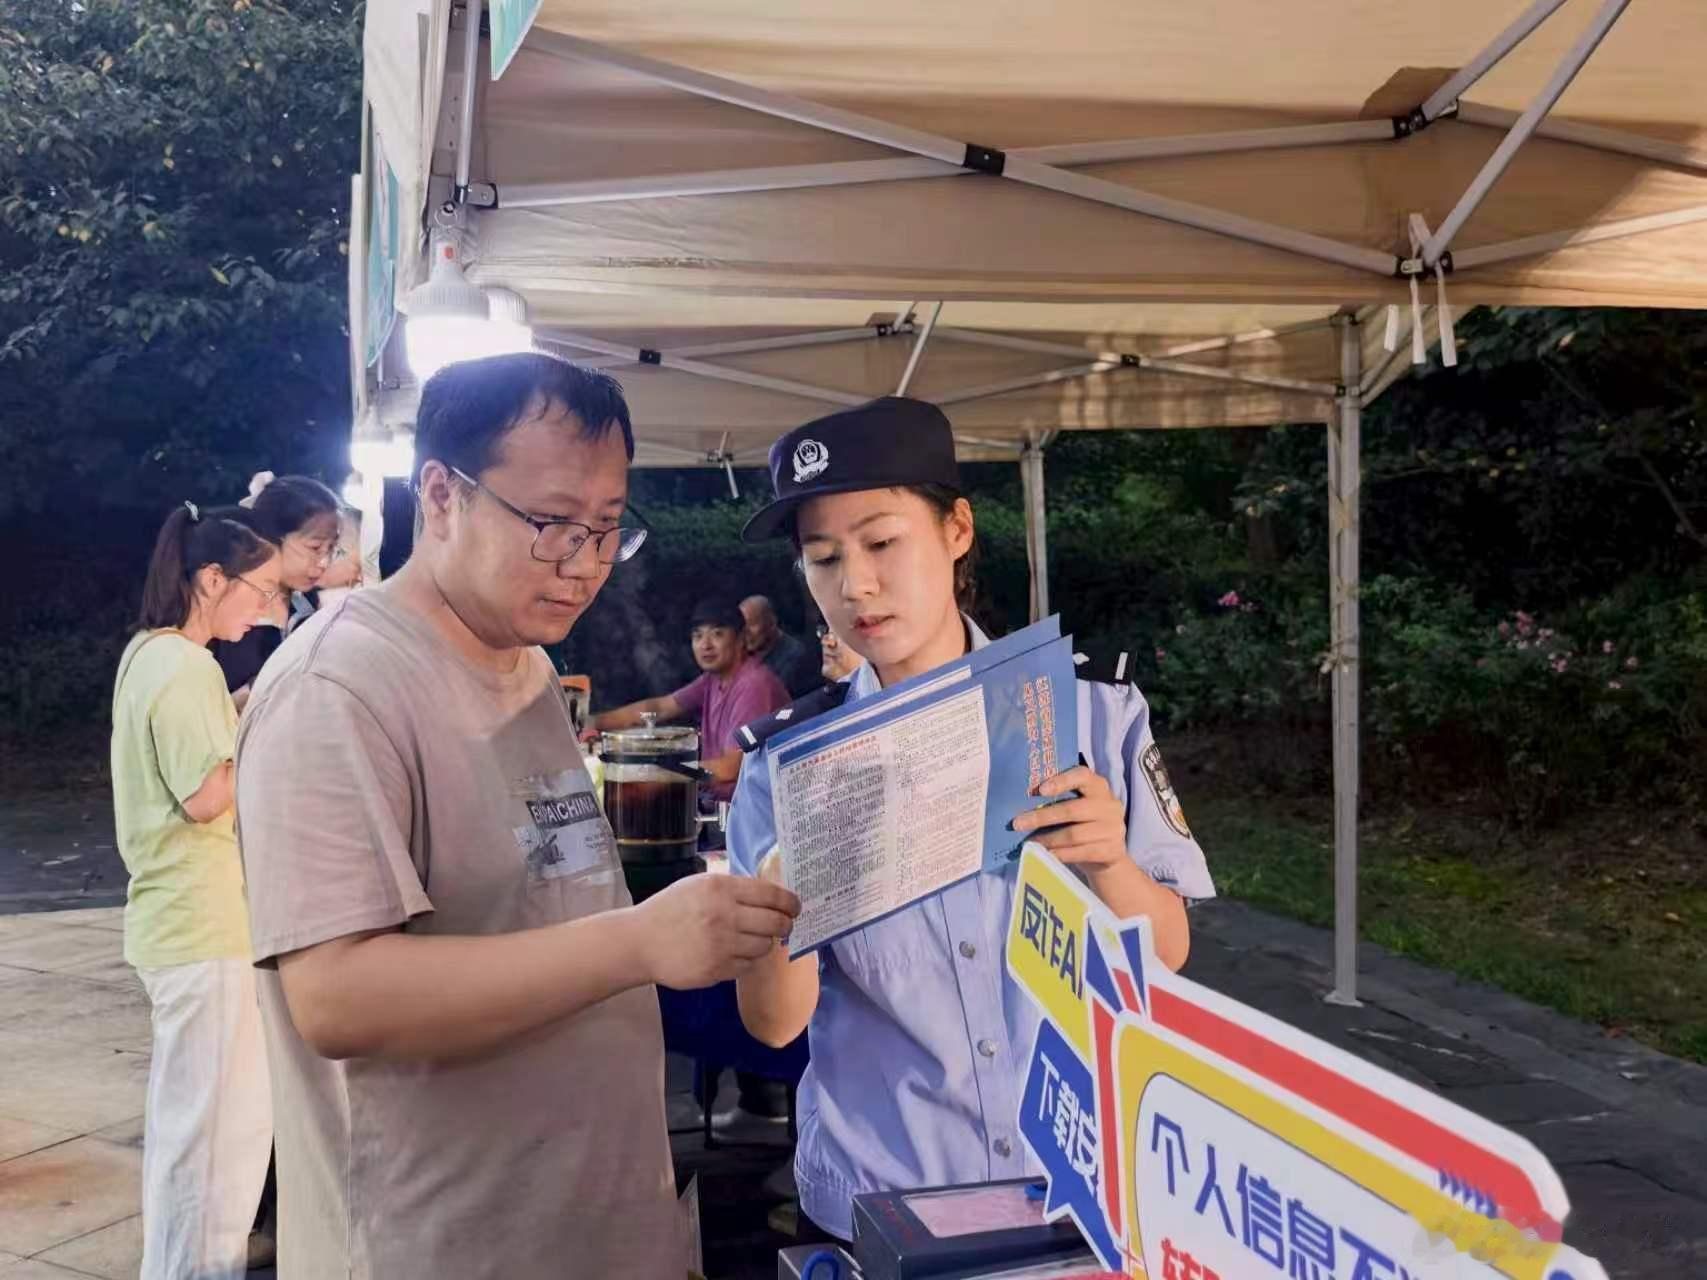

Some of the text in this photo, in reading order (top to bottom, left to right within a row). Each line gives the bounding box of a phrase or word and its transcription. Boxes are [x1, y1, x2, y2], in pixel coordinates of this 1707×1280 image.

[1151, 1112, 1421, 1280] 个人信息不
